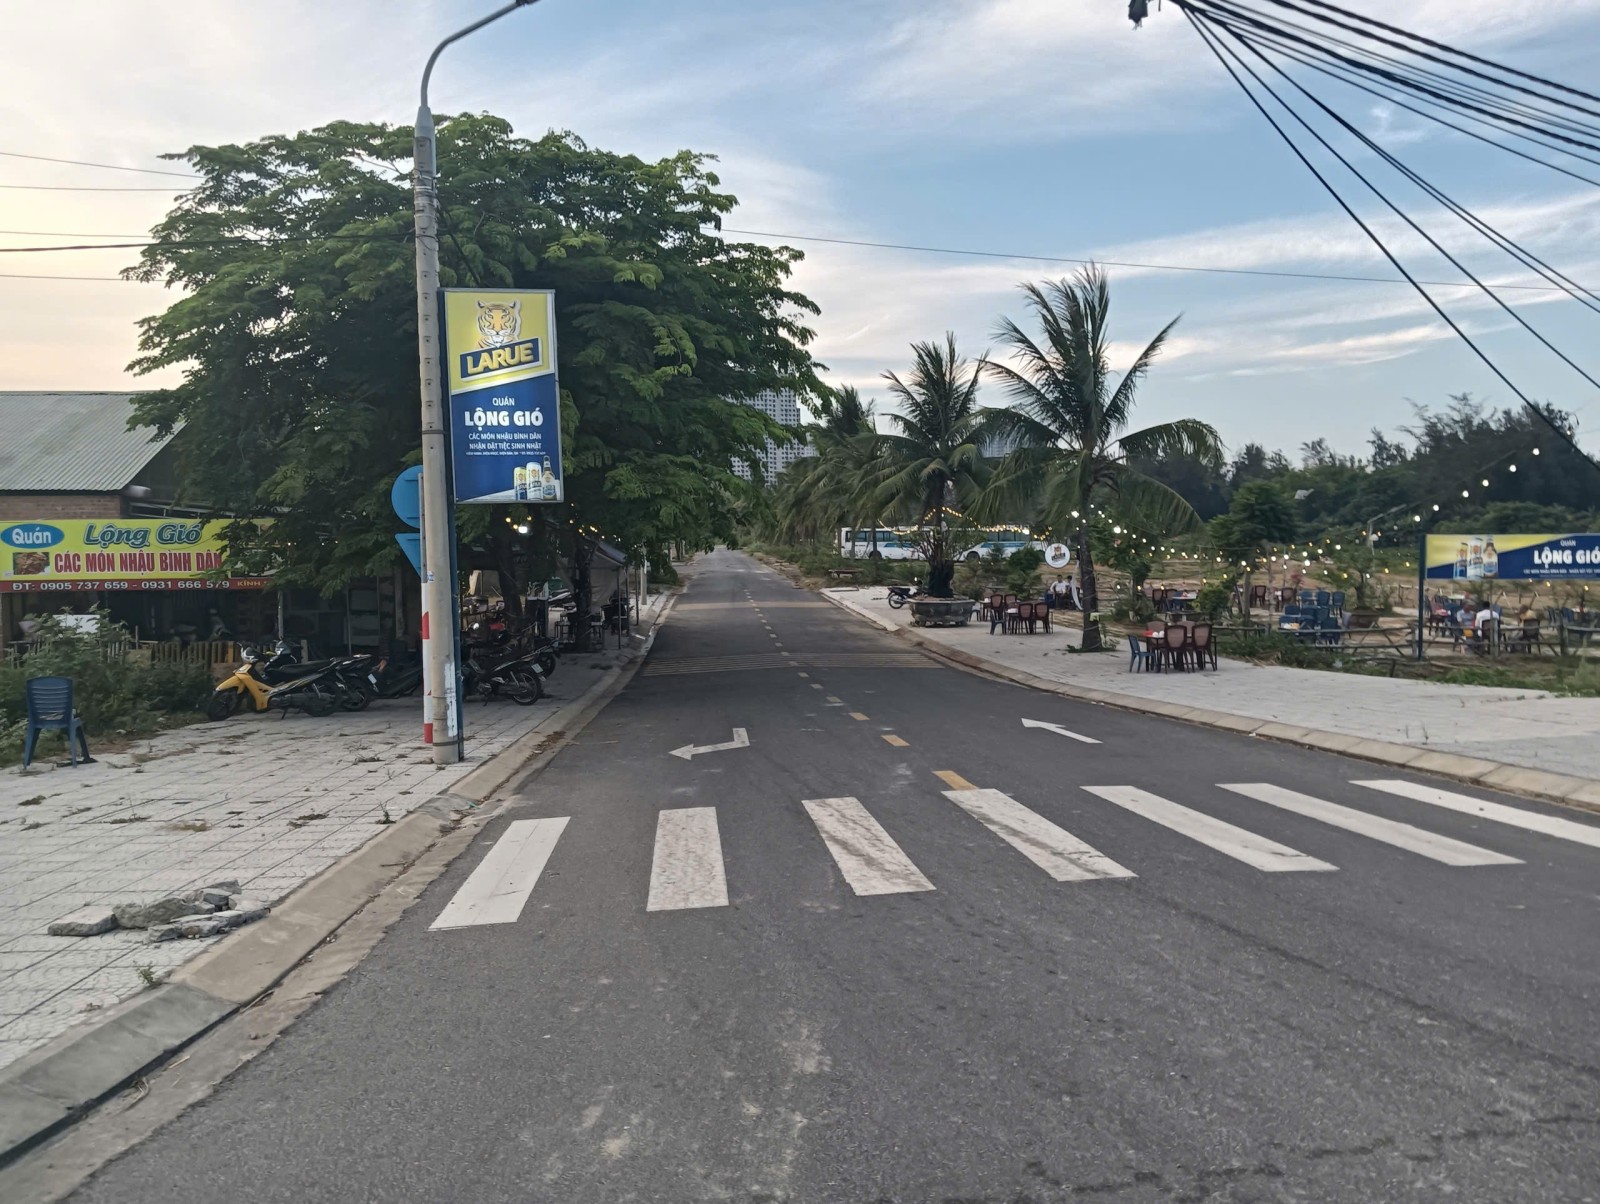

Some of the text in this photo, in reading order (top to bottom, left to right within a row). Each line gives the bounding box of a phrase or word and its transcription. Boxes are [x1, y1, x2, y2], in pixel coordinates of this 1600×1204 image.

[466, 342, 534, 375] LARUE
[492, 396, 515, 406] QUÁN
[464, 407, 544, 431] LỘNG GIÓ
[468, 432, 480, 440] CÁC
[481, 432, 495, 440] MÓN
[514, 432, 528, 440] BÌNH
[12, 527, 52, 545] Quán
[84, 521, 202, 549] Lộng Gió
[54, 550, 81, 573] CÁC
[85, 550, 115, 573] MÓN
[120, 549, 155, 575] NHẬU
[159, 549, 192, 572] BÌNH
[1533, 545, 1600, 569] LỘNG GIÓ
[12, 582, 35, 591] ĐT:
[40, 582, 72, 591] 0905
[77, 581, 99, 590] 737
[104, 581, 128, 590] 659
[141, 581, 172, 589] 0931
[177, 581, 202, 589] 666
[206, 580, 230, 589] 579
